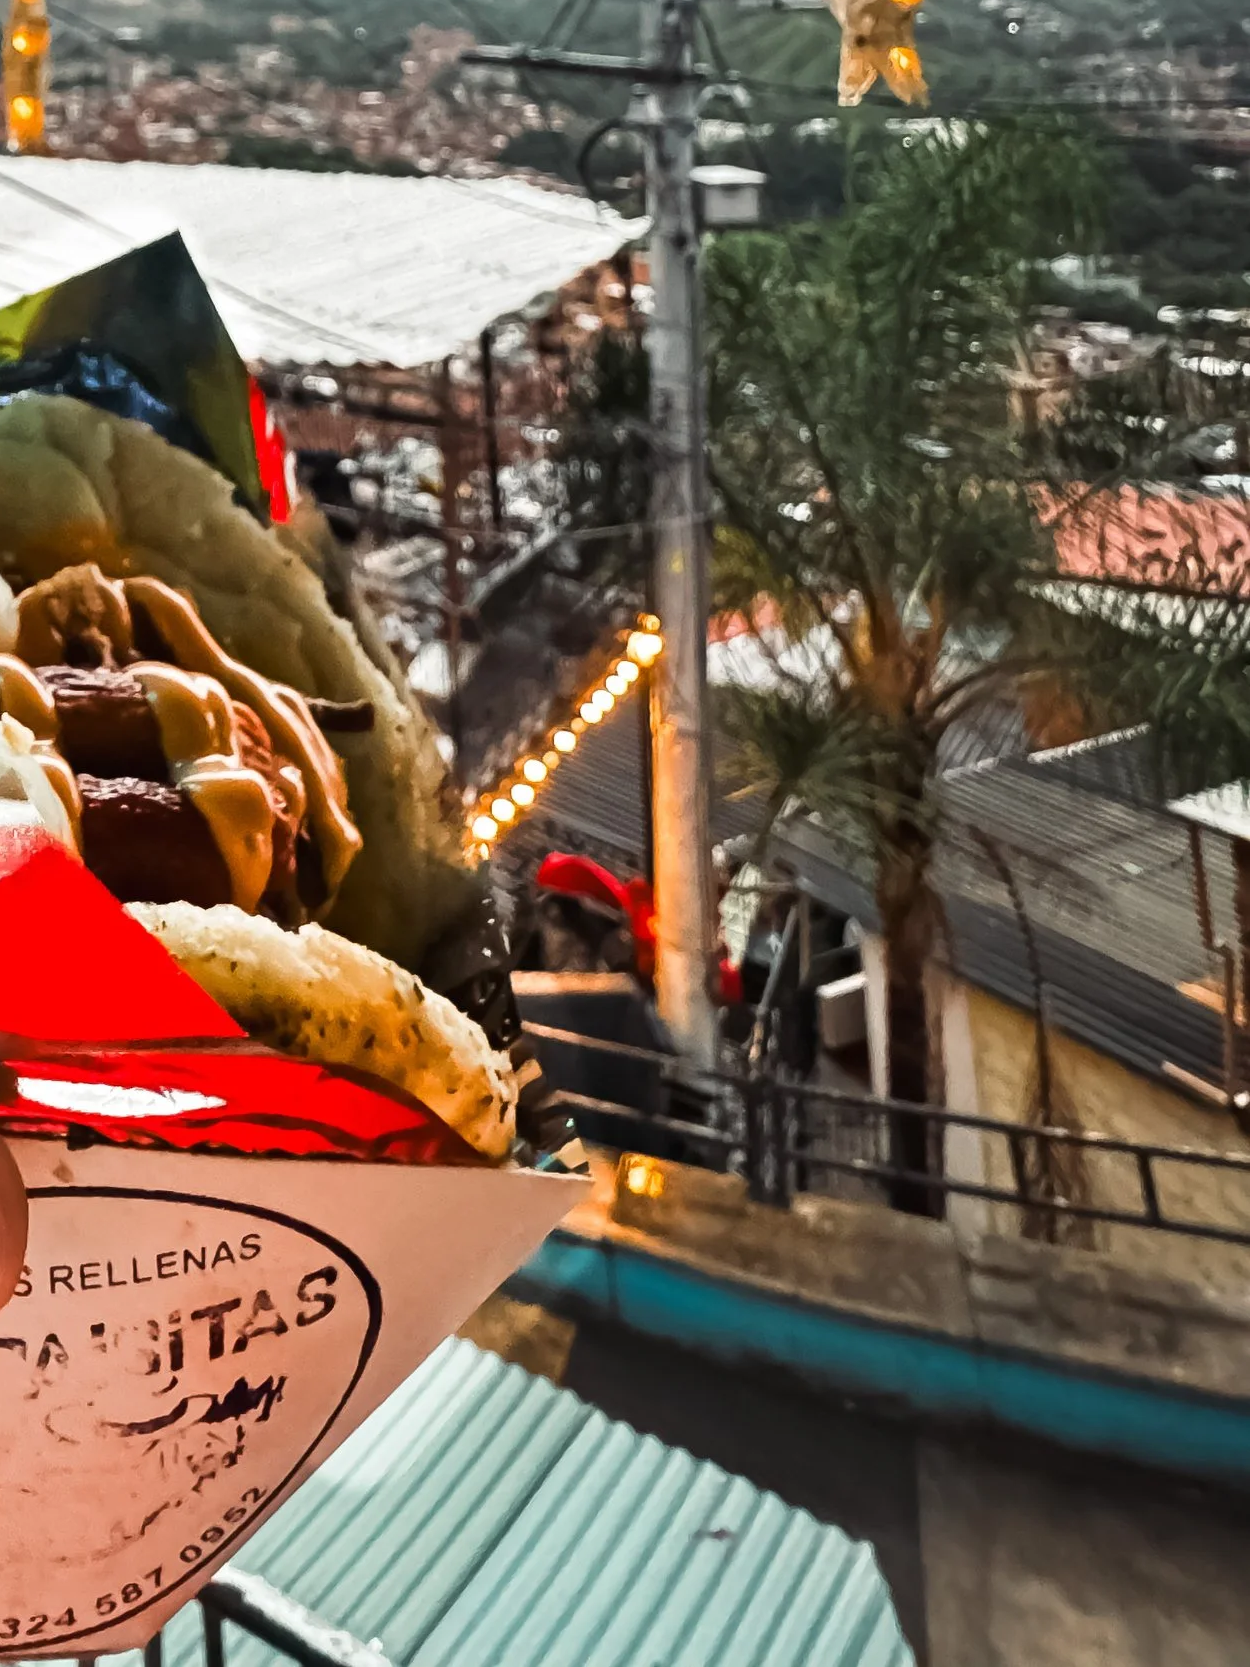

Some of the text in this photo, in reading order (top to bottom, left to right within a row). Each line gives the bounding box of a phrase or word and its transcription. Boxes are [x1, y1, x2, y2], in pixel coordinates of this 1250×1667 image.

[49, 1233, 263, 1295] RELLENAS
[95, 1565, 164, 1617] 587
[179, 1485, 267, 1564] 0952
